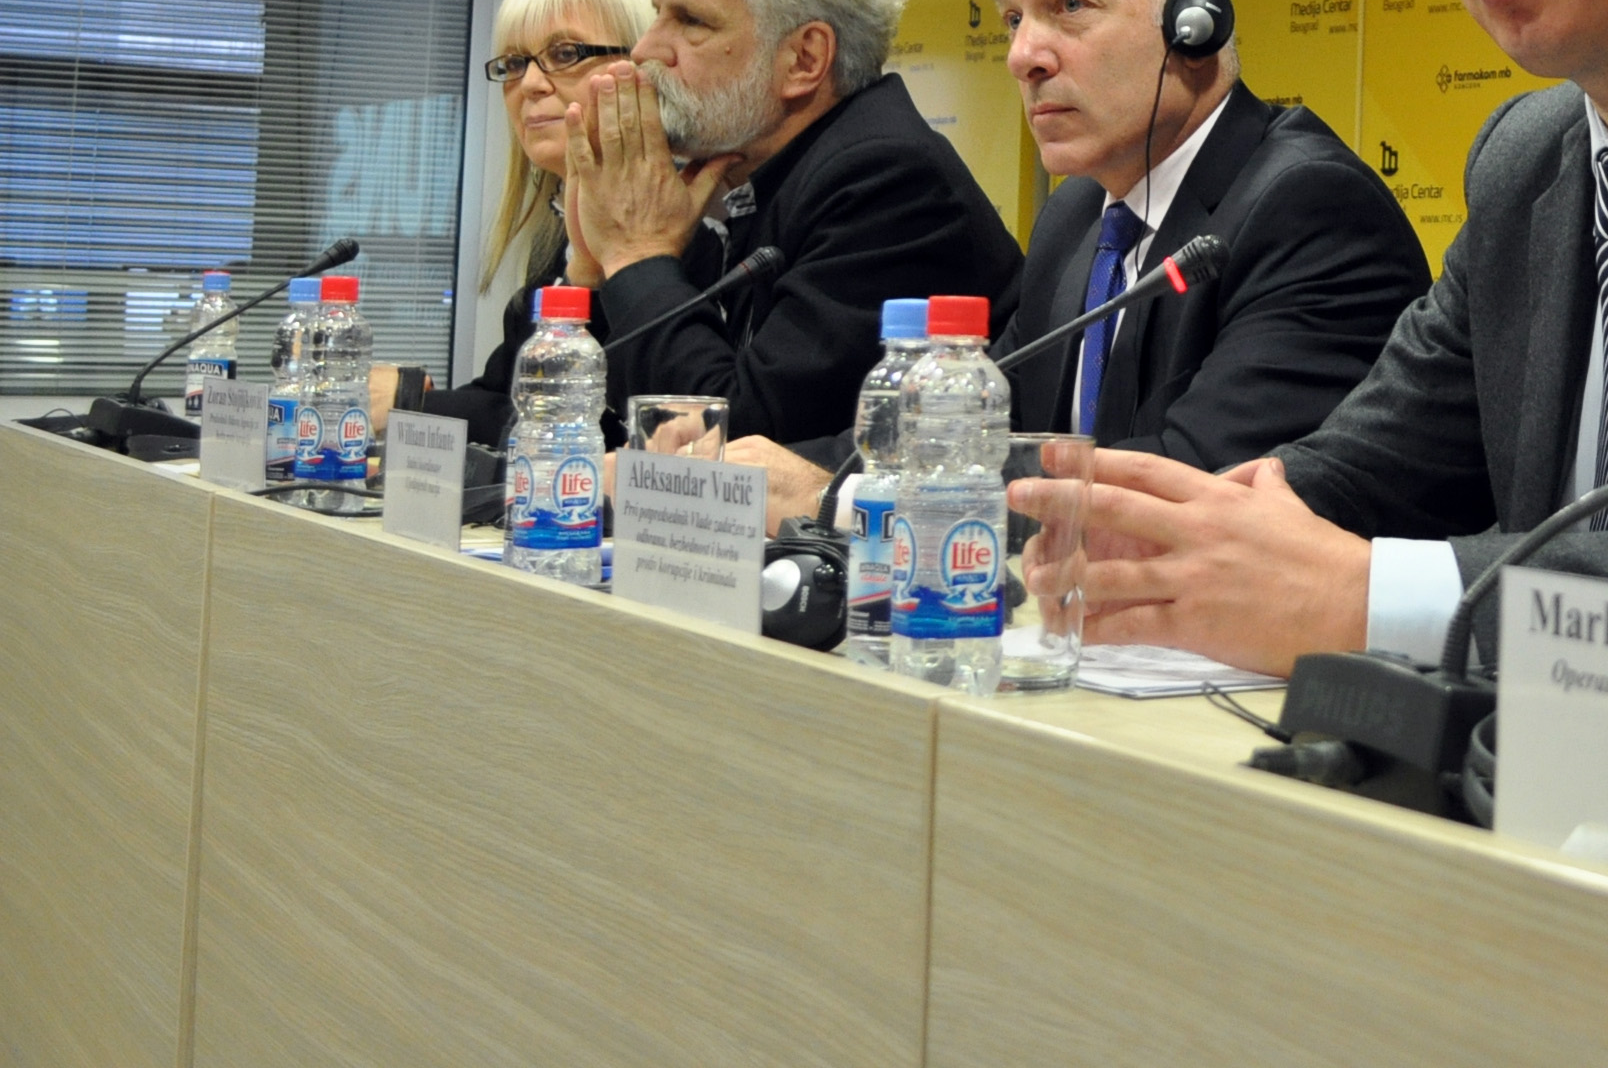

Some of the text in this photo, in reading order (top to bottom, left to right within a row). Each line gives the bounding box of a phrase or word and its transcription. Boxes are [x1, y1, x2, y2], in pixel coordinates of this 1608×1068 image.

[1410, 184, 1444, 200] Centar
[344, 421, 365, 439] Life
[561, 472, 592, 496] Life
[628, 461, 753, 506] Aleksandar Vučić
[952, 541, 991, 570] Life
